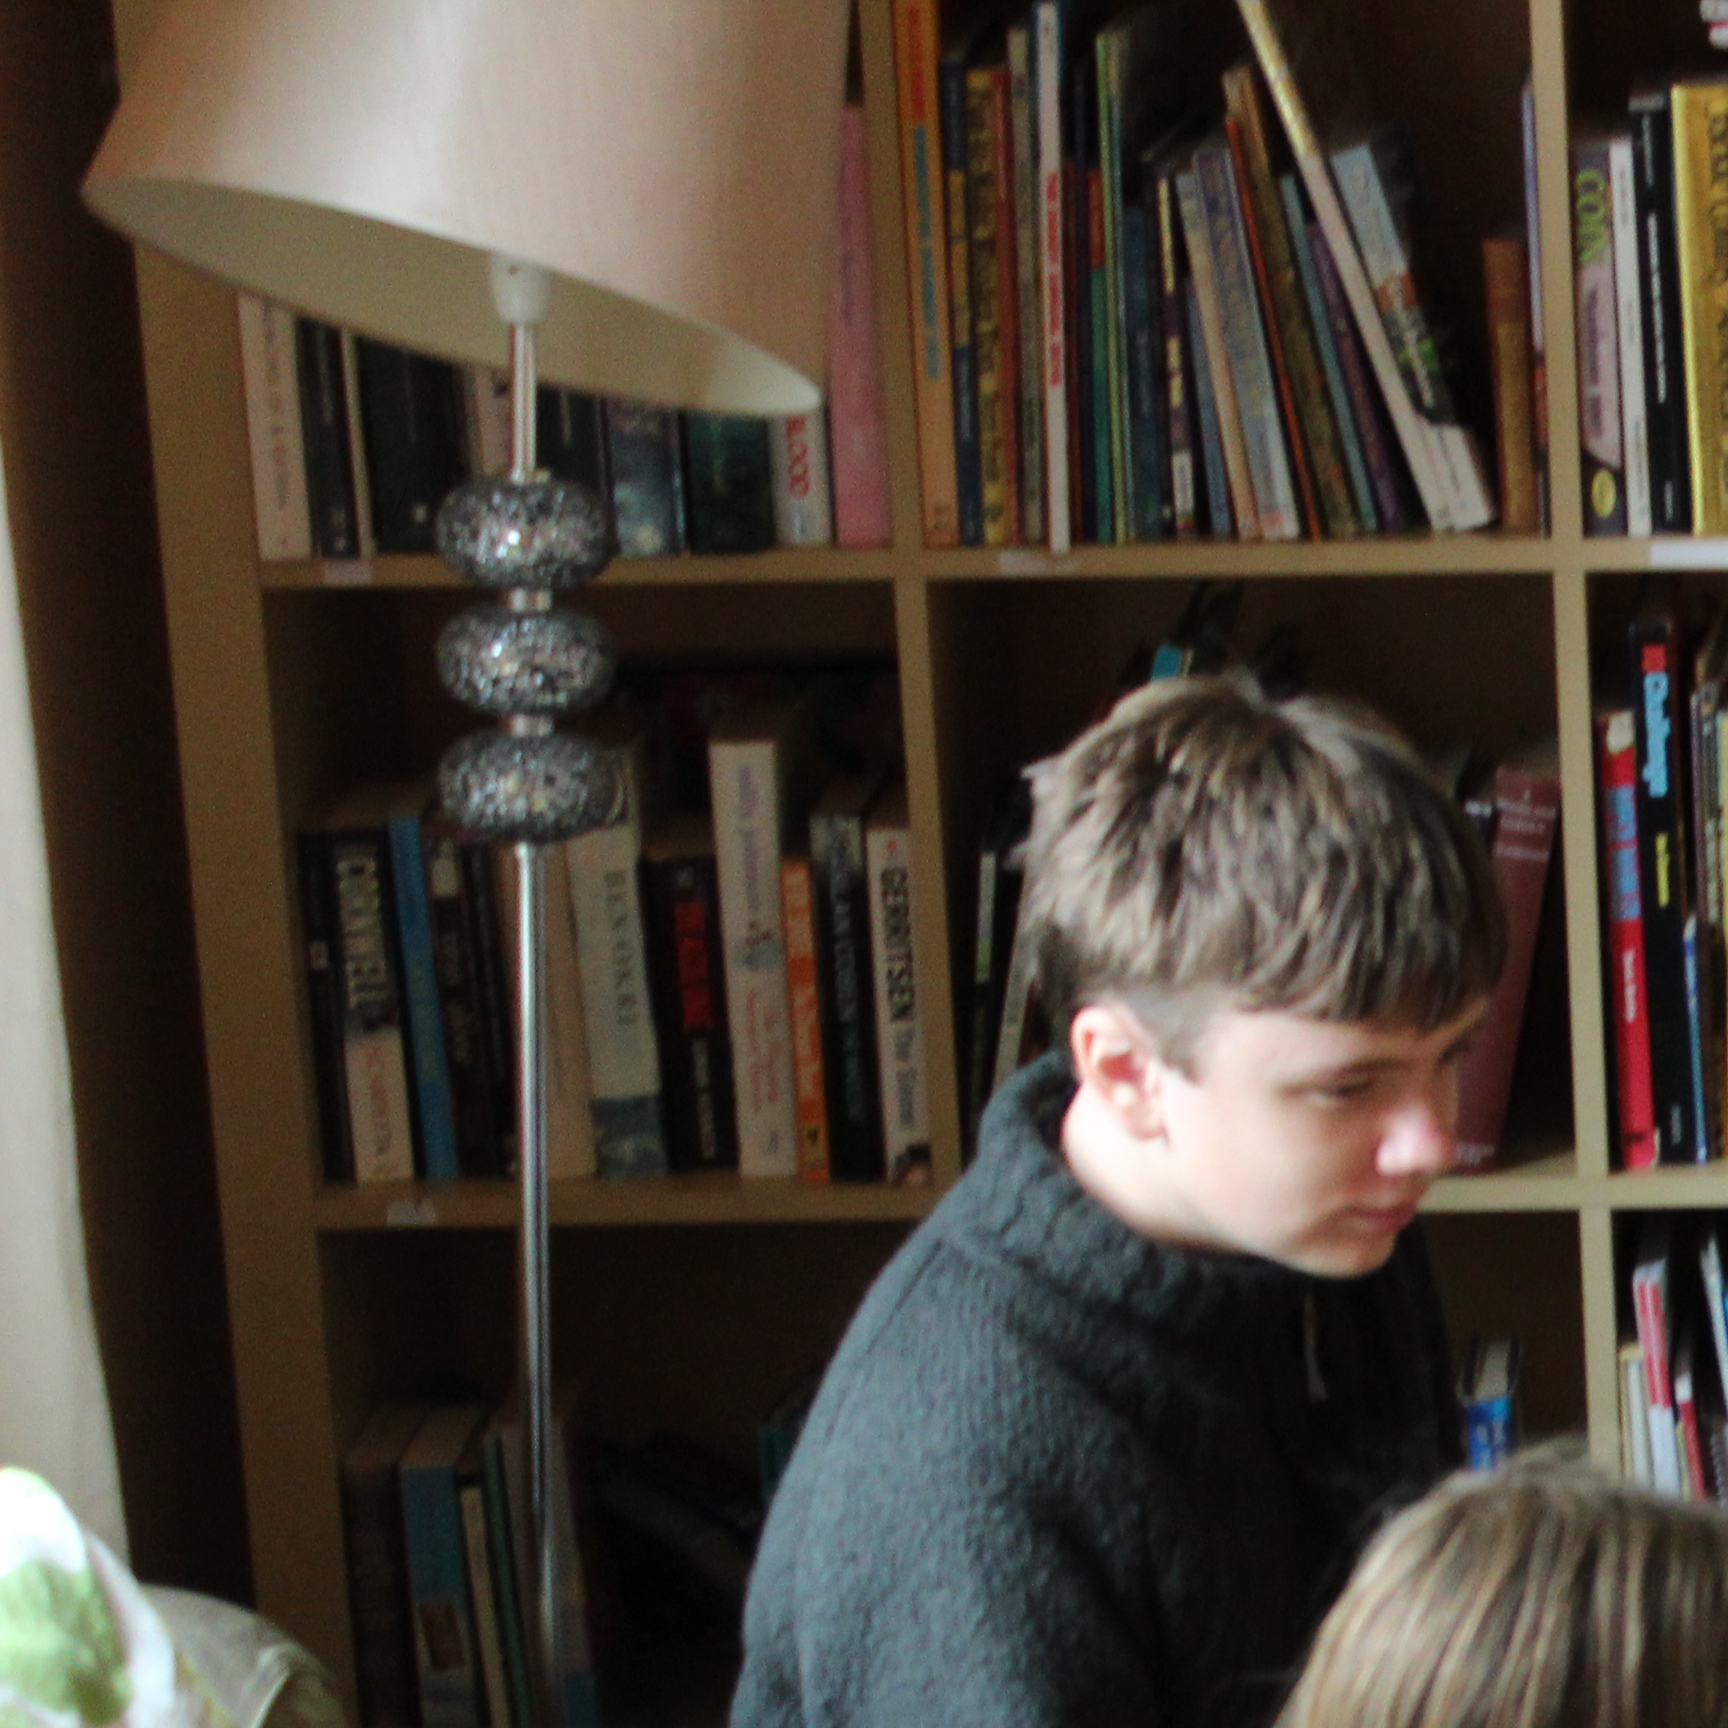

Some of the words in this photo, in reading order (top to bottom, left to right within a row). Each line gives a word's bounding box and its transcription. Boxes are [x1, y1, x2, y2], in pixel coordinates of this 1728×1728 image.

[1577, 168, 1609, 263] COIN
[1642, 674, 1671, 797] Challenge
[338, 854, 391, 1012] CORNWELL
[602, 868, 630, 928] BEN
[880, 866, 916, 1022] GERRITSEN
[610, 931, 639, 1029] OKRI
